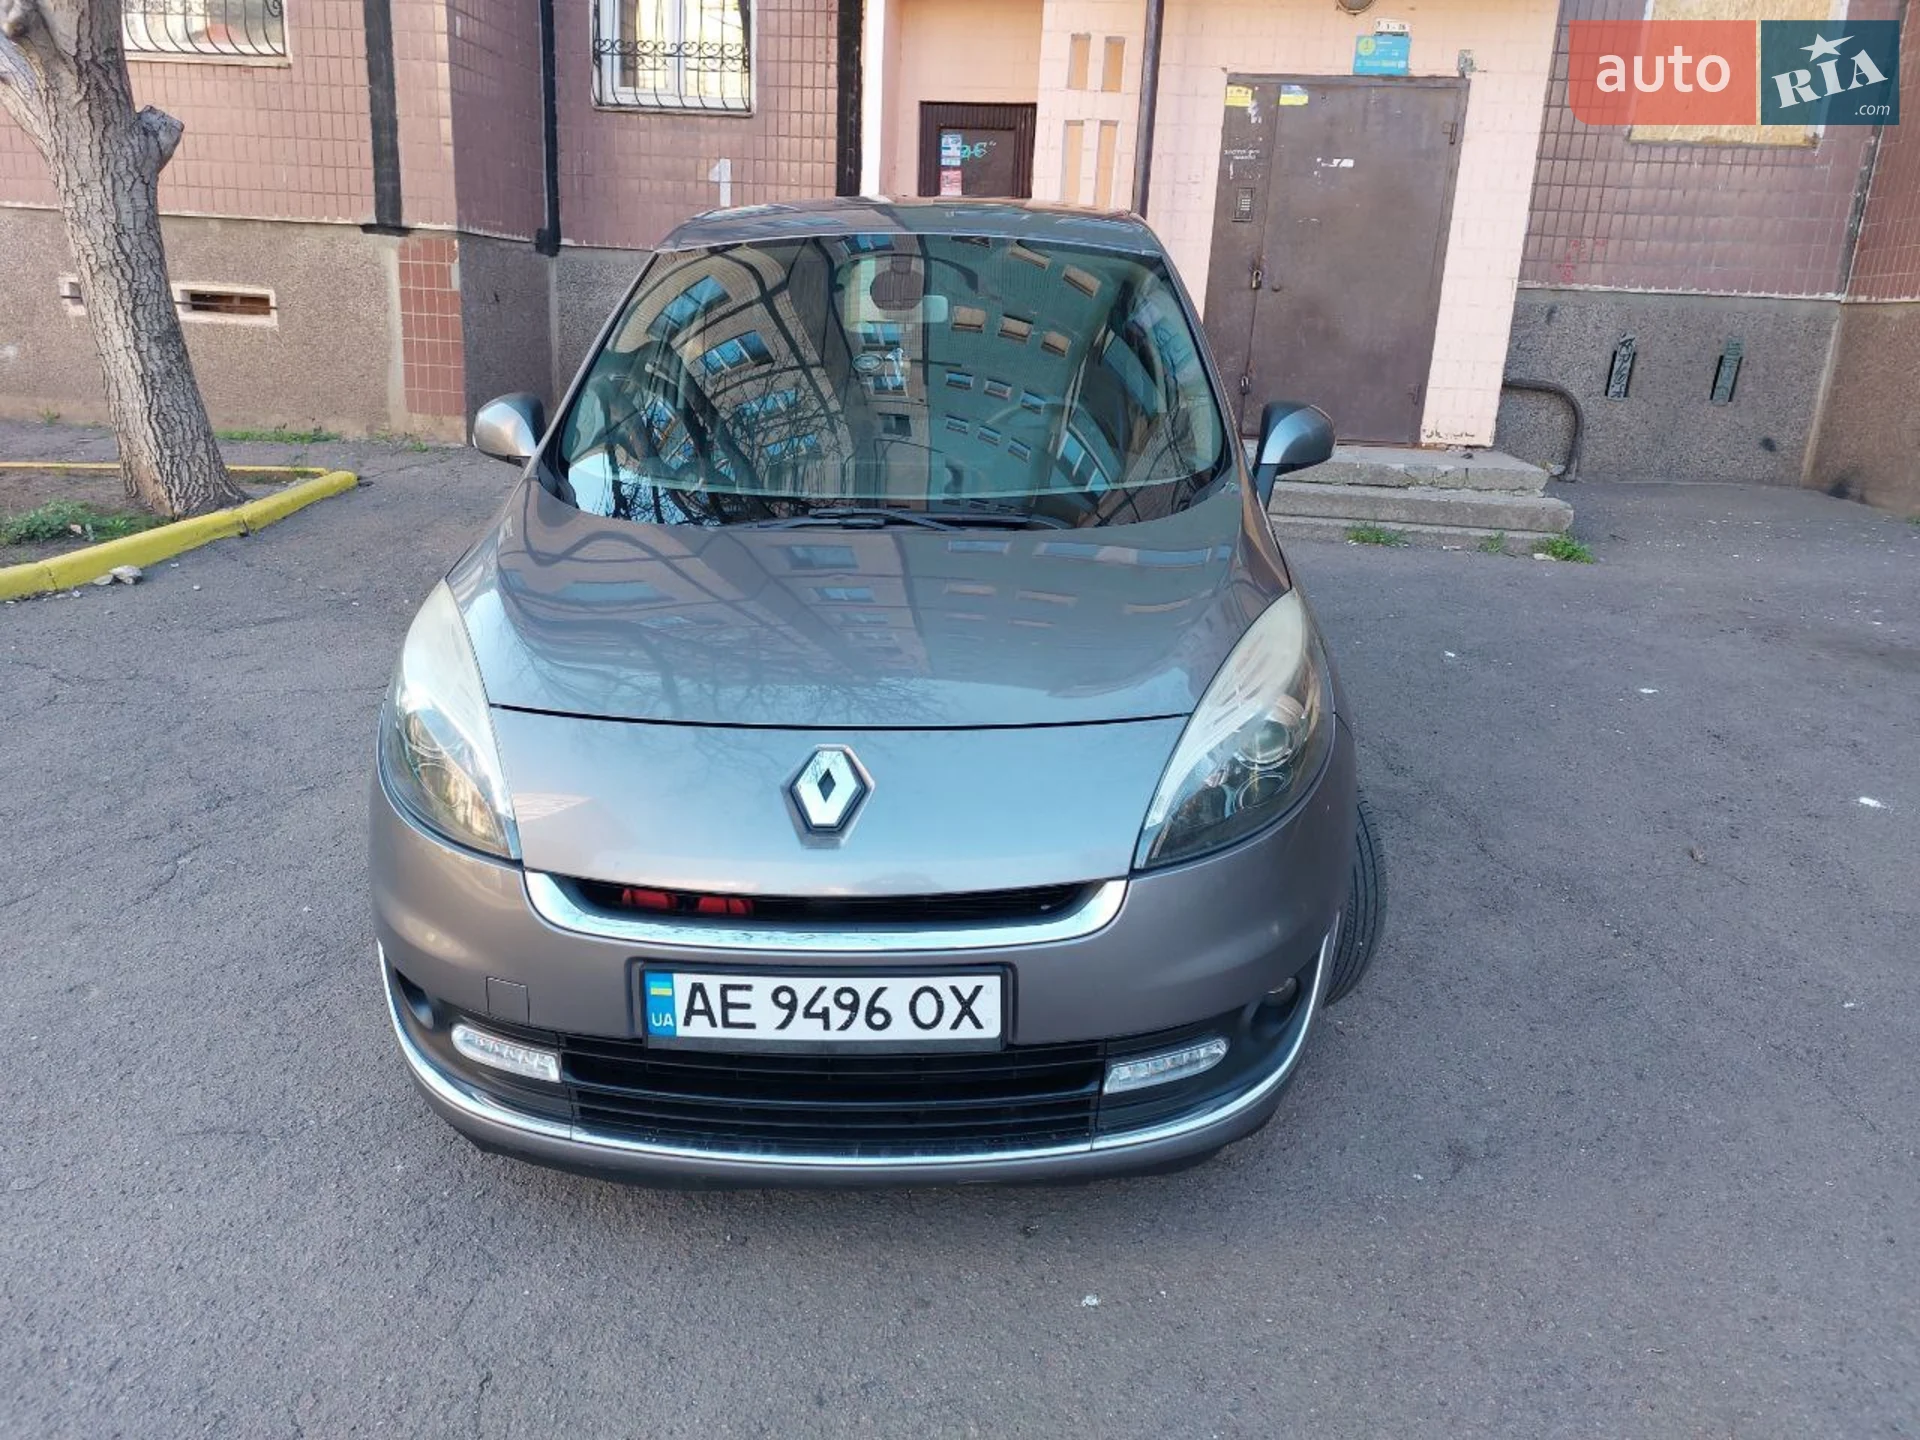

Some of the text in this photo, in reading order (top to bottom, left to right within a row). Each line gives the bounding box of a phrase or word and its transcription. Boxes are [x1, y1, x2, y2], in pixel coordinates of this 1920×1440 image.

[708, 158, 731, 207] 1
[652, 1012, 674, 1027] UA
[683, 982, 984, 1031] AE 9496 OX
